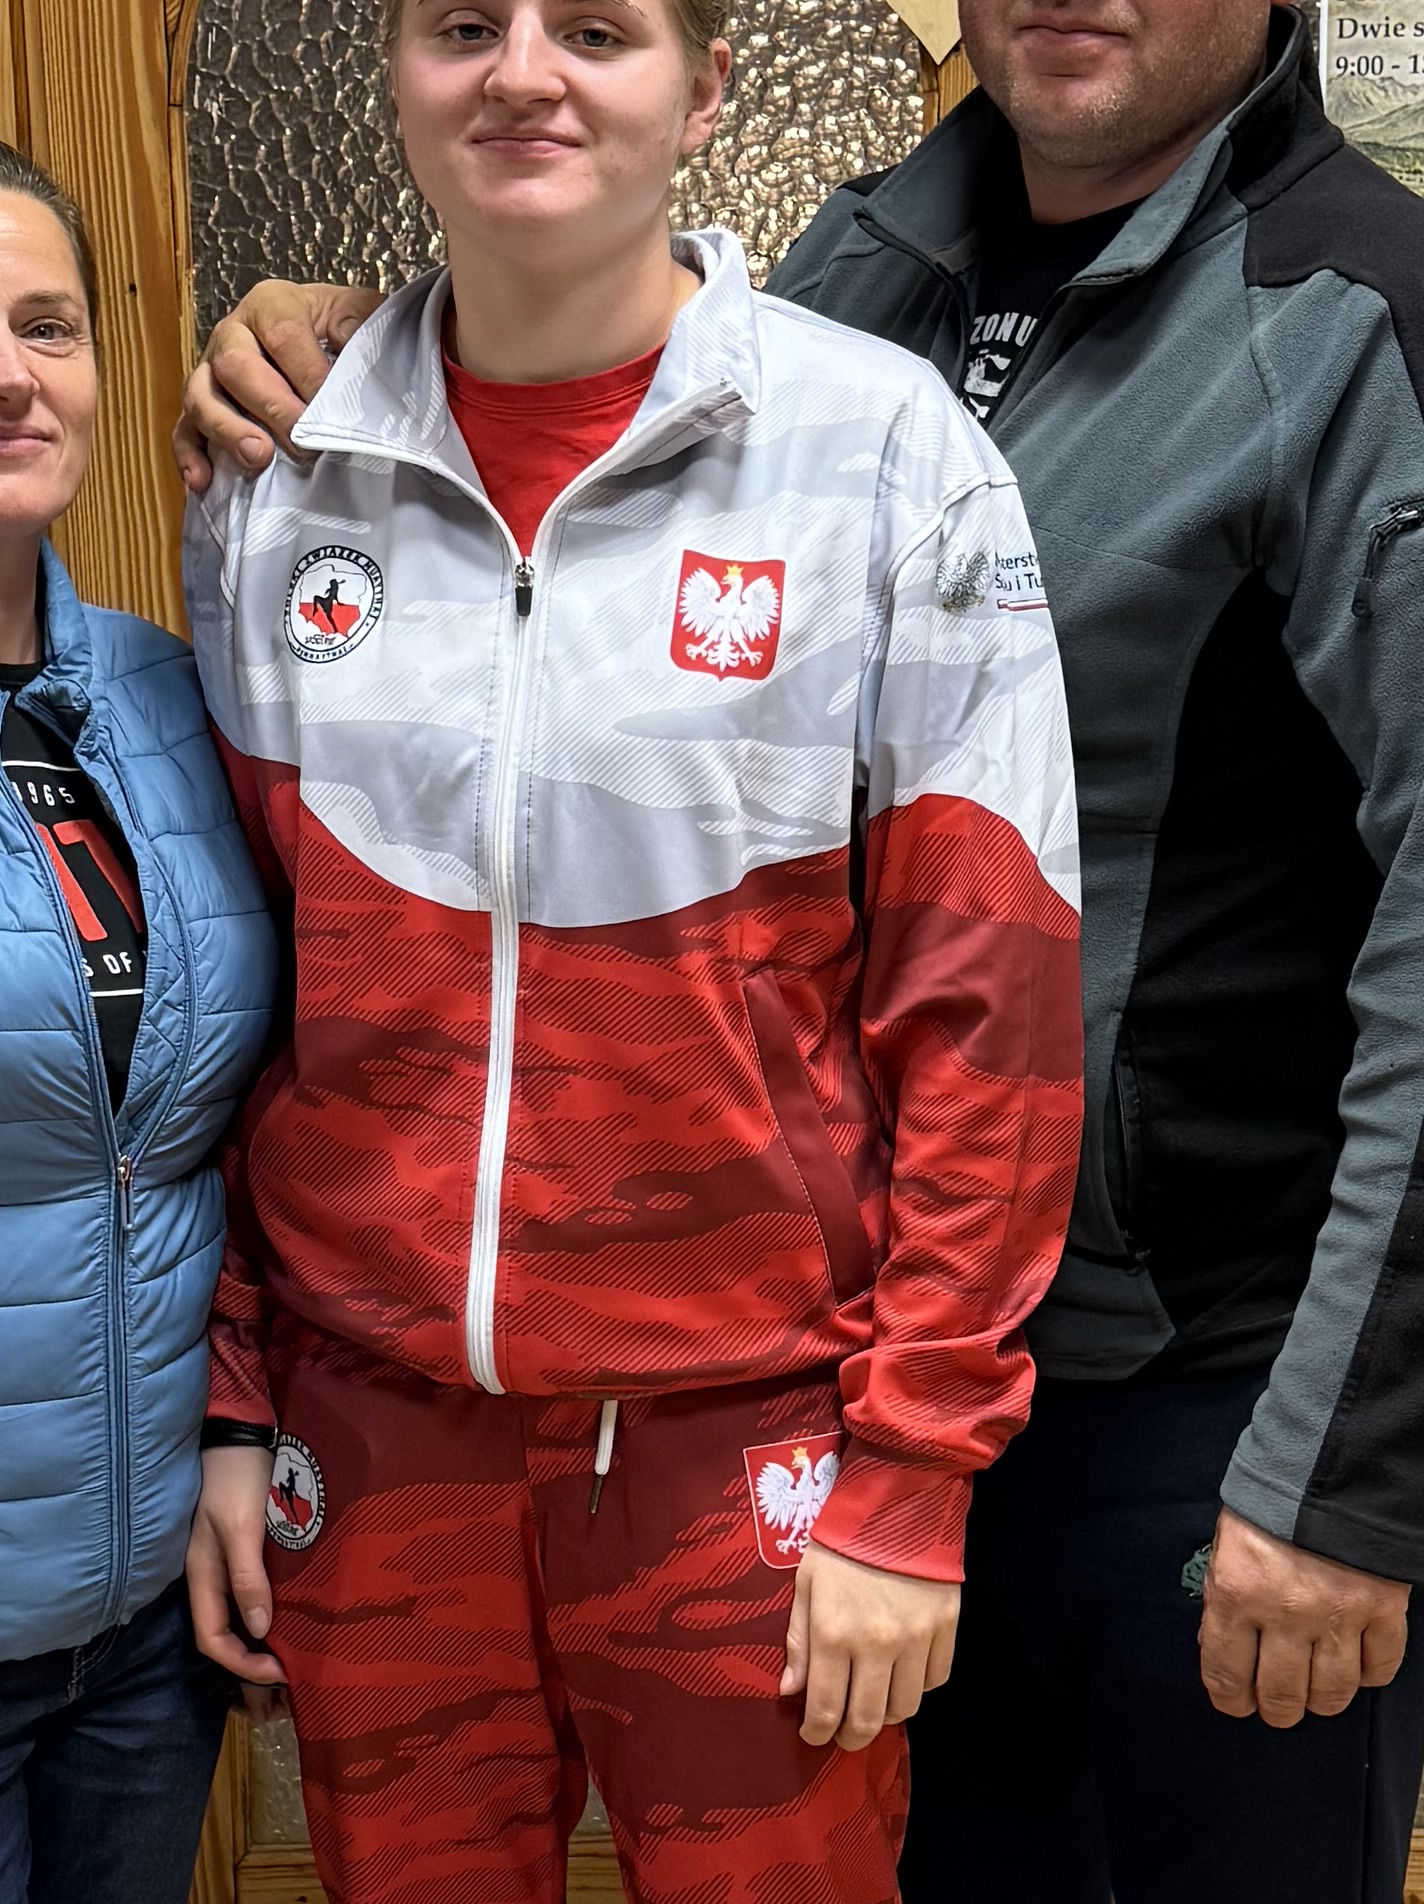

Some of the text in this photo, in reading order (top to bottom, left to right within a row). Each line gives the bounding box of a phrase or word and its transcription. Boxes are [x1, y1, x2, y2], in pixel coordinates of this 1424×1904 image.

[1337, 16, 1406, 39] Dwie
[1335, 55, 1384, 77] 9:00
[102, 951, 133, 975] OF
